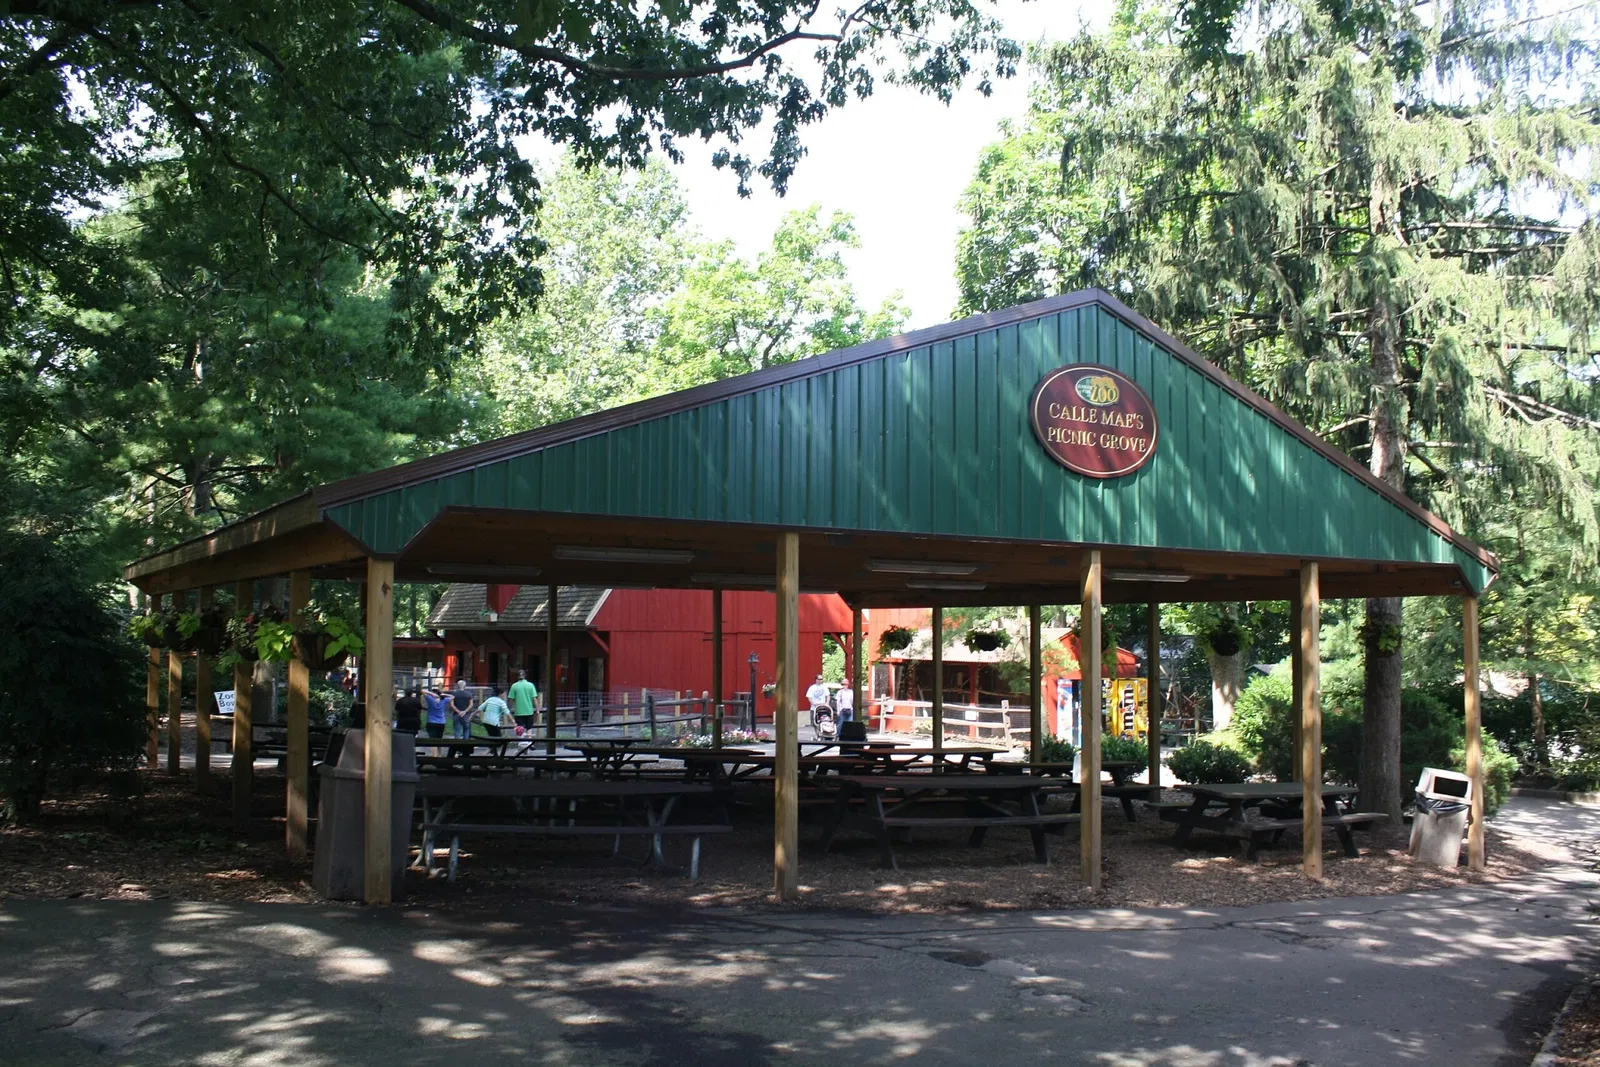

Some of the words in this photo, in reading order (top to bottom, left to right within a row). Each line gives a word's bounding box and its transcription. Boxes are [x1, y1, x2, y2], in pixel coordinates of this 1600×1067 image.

[1090, 384, 1116, 402] ZOO
[1049, 402, 1098, 423] CALLE
[1101, 410, 1144, 430] MAE'S
[1047, 427, 1097, 446] PICNIC
[1100, 433, 1146, 452] GROVE
